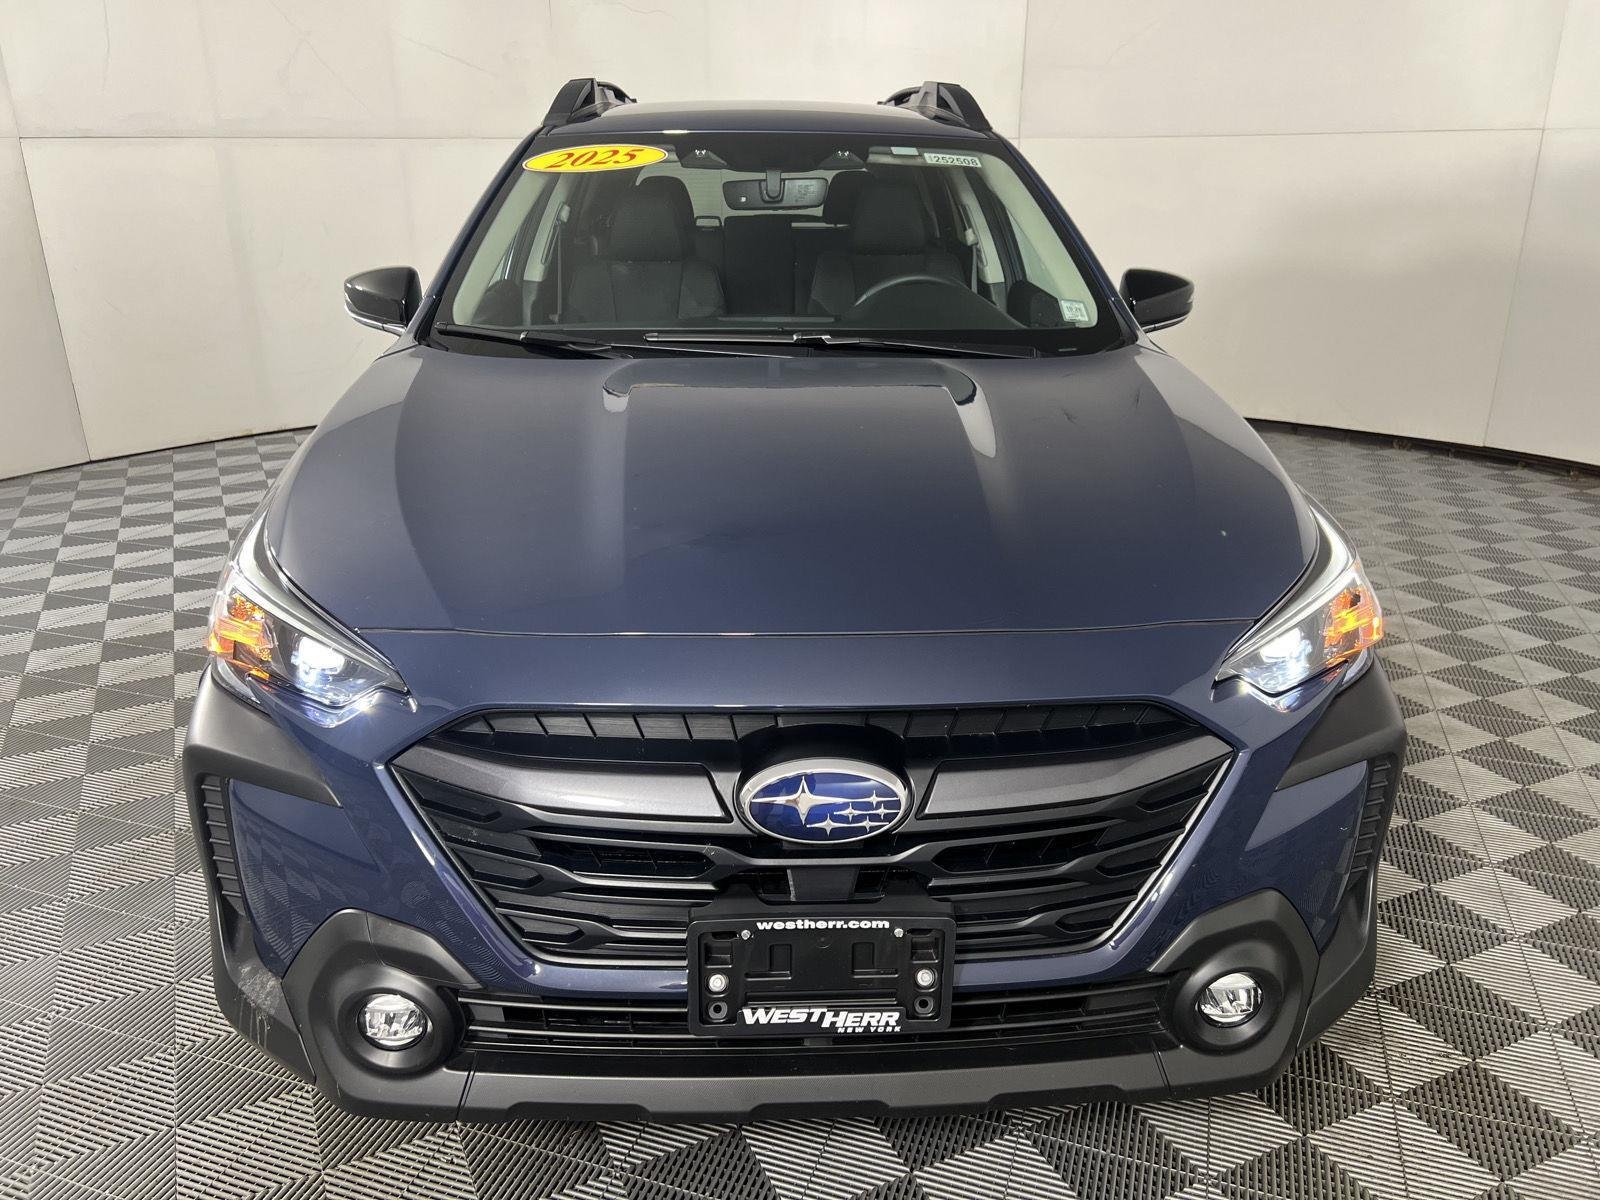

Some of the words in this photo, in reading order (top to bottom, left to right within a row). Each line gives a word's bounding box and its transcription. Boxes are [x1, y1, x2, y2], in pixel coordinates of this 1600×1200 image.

[544, 149, 644, 169] 2025
[933, 155, 979, 166] 252508
[756, 919, 889, 930] westherr.com
